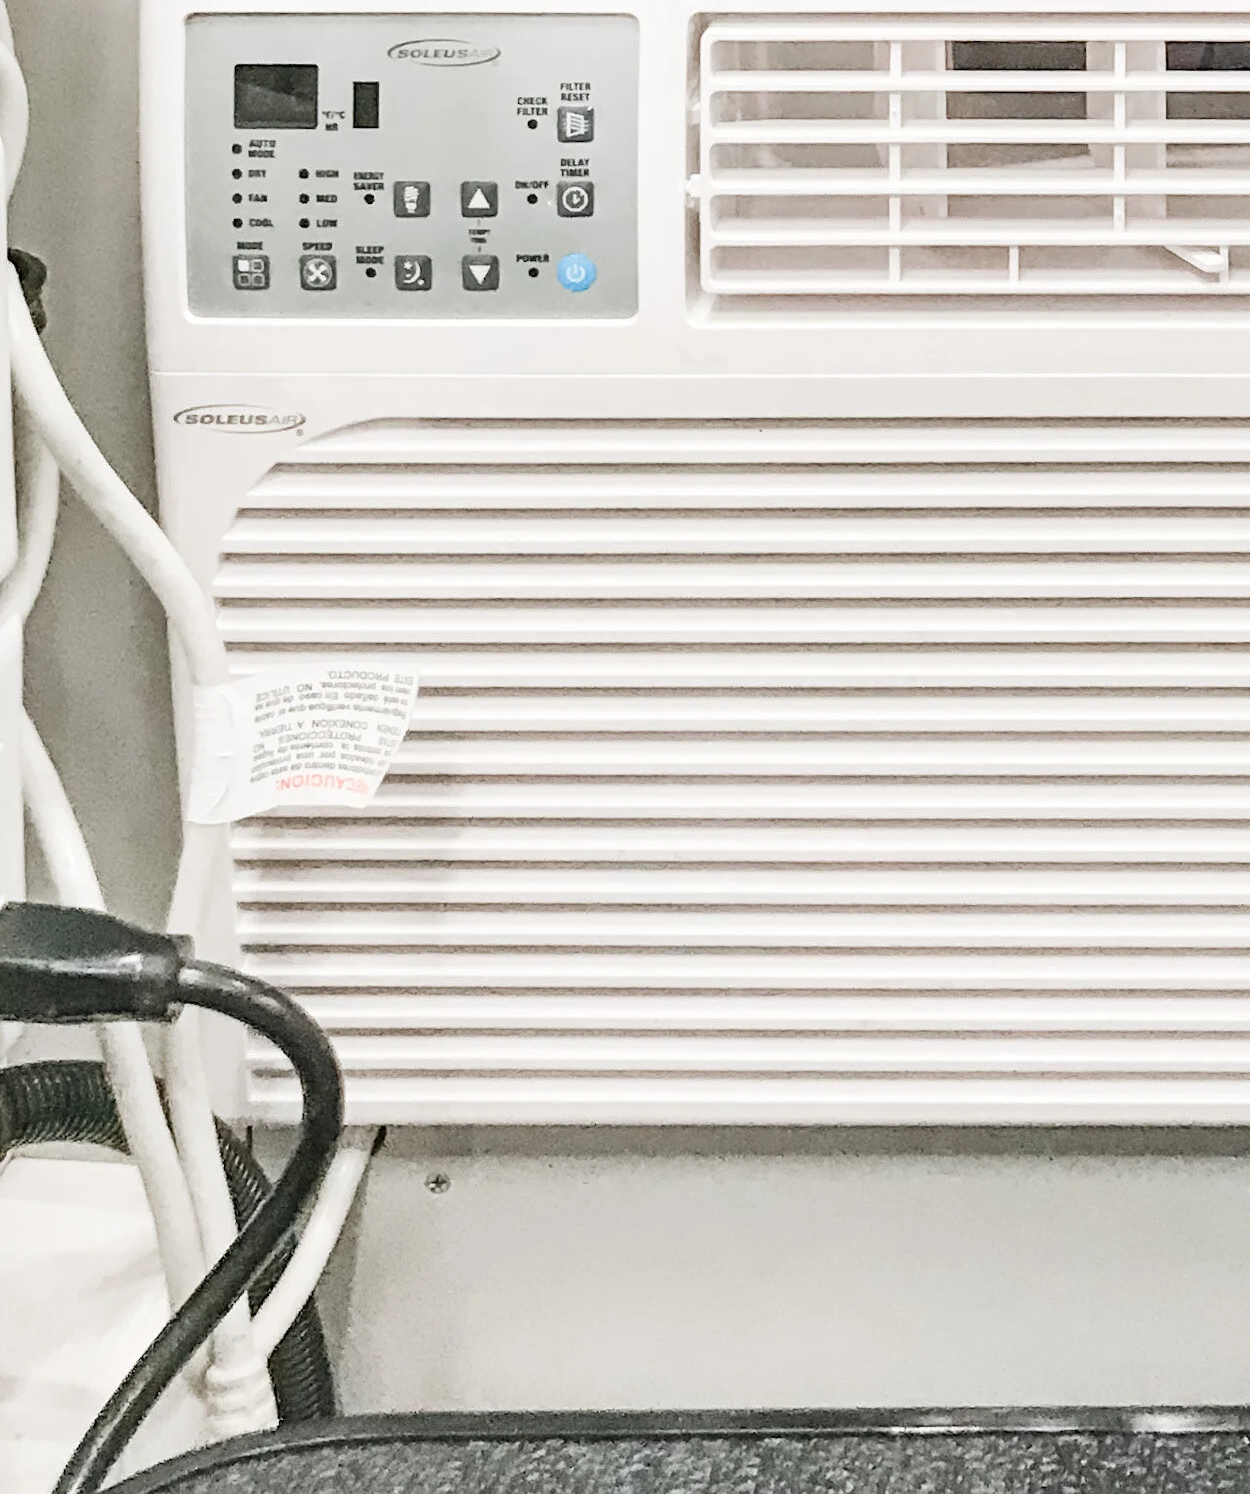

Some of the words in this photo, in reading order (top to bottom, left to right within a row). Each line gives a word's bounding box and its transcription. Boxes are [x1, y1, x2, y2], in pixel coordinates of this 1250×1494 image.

[560, 82, 591, 91] FILTER
[517, 96, 548, 105] CHECK
[560, 92, 590, 101] RESET
[516, 107, 549, 116] FILTER
[560, 158, 590, 167] DELAY
[560, 168, 590, 177] TIMER
[515, 180, 549, 189] ON/OFF
[316, 219, 338, 227] LOW
[236, 241, 264, 250] MODE
[302, 242, 333, 251] SPEED
[355, 246, 385, 254] SLEEP
[356, 256, 385, 265] MODE
[516, 253, 550, 263] POWER
[184, 414, 298, 425] SOLEUSAIR
[297, 721, 304, 730] A
[279, 729, 362, 745] PROTECCIONES
